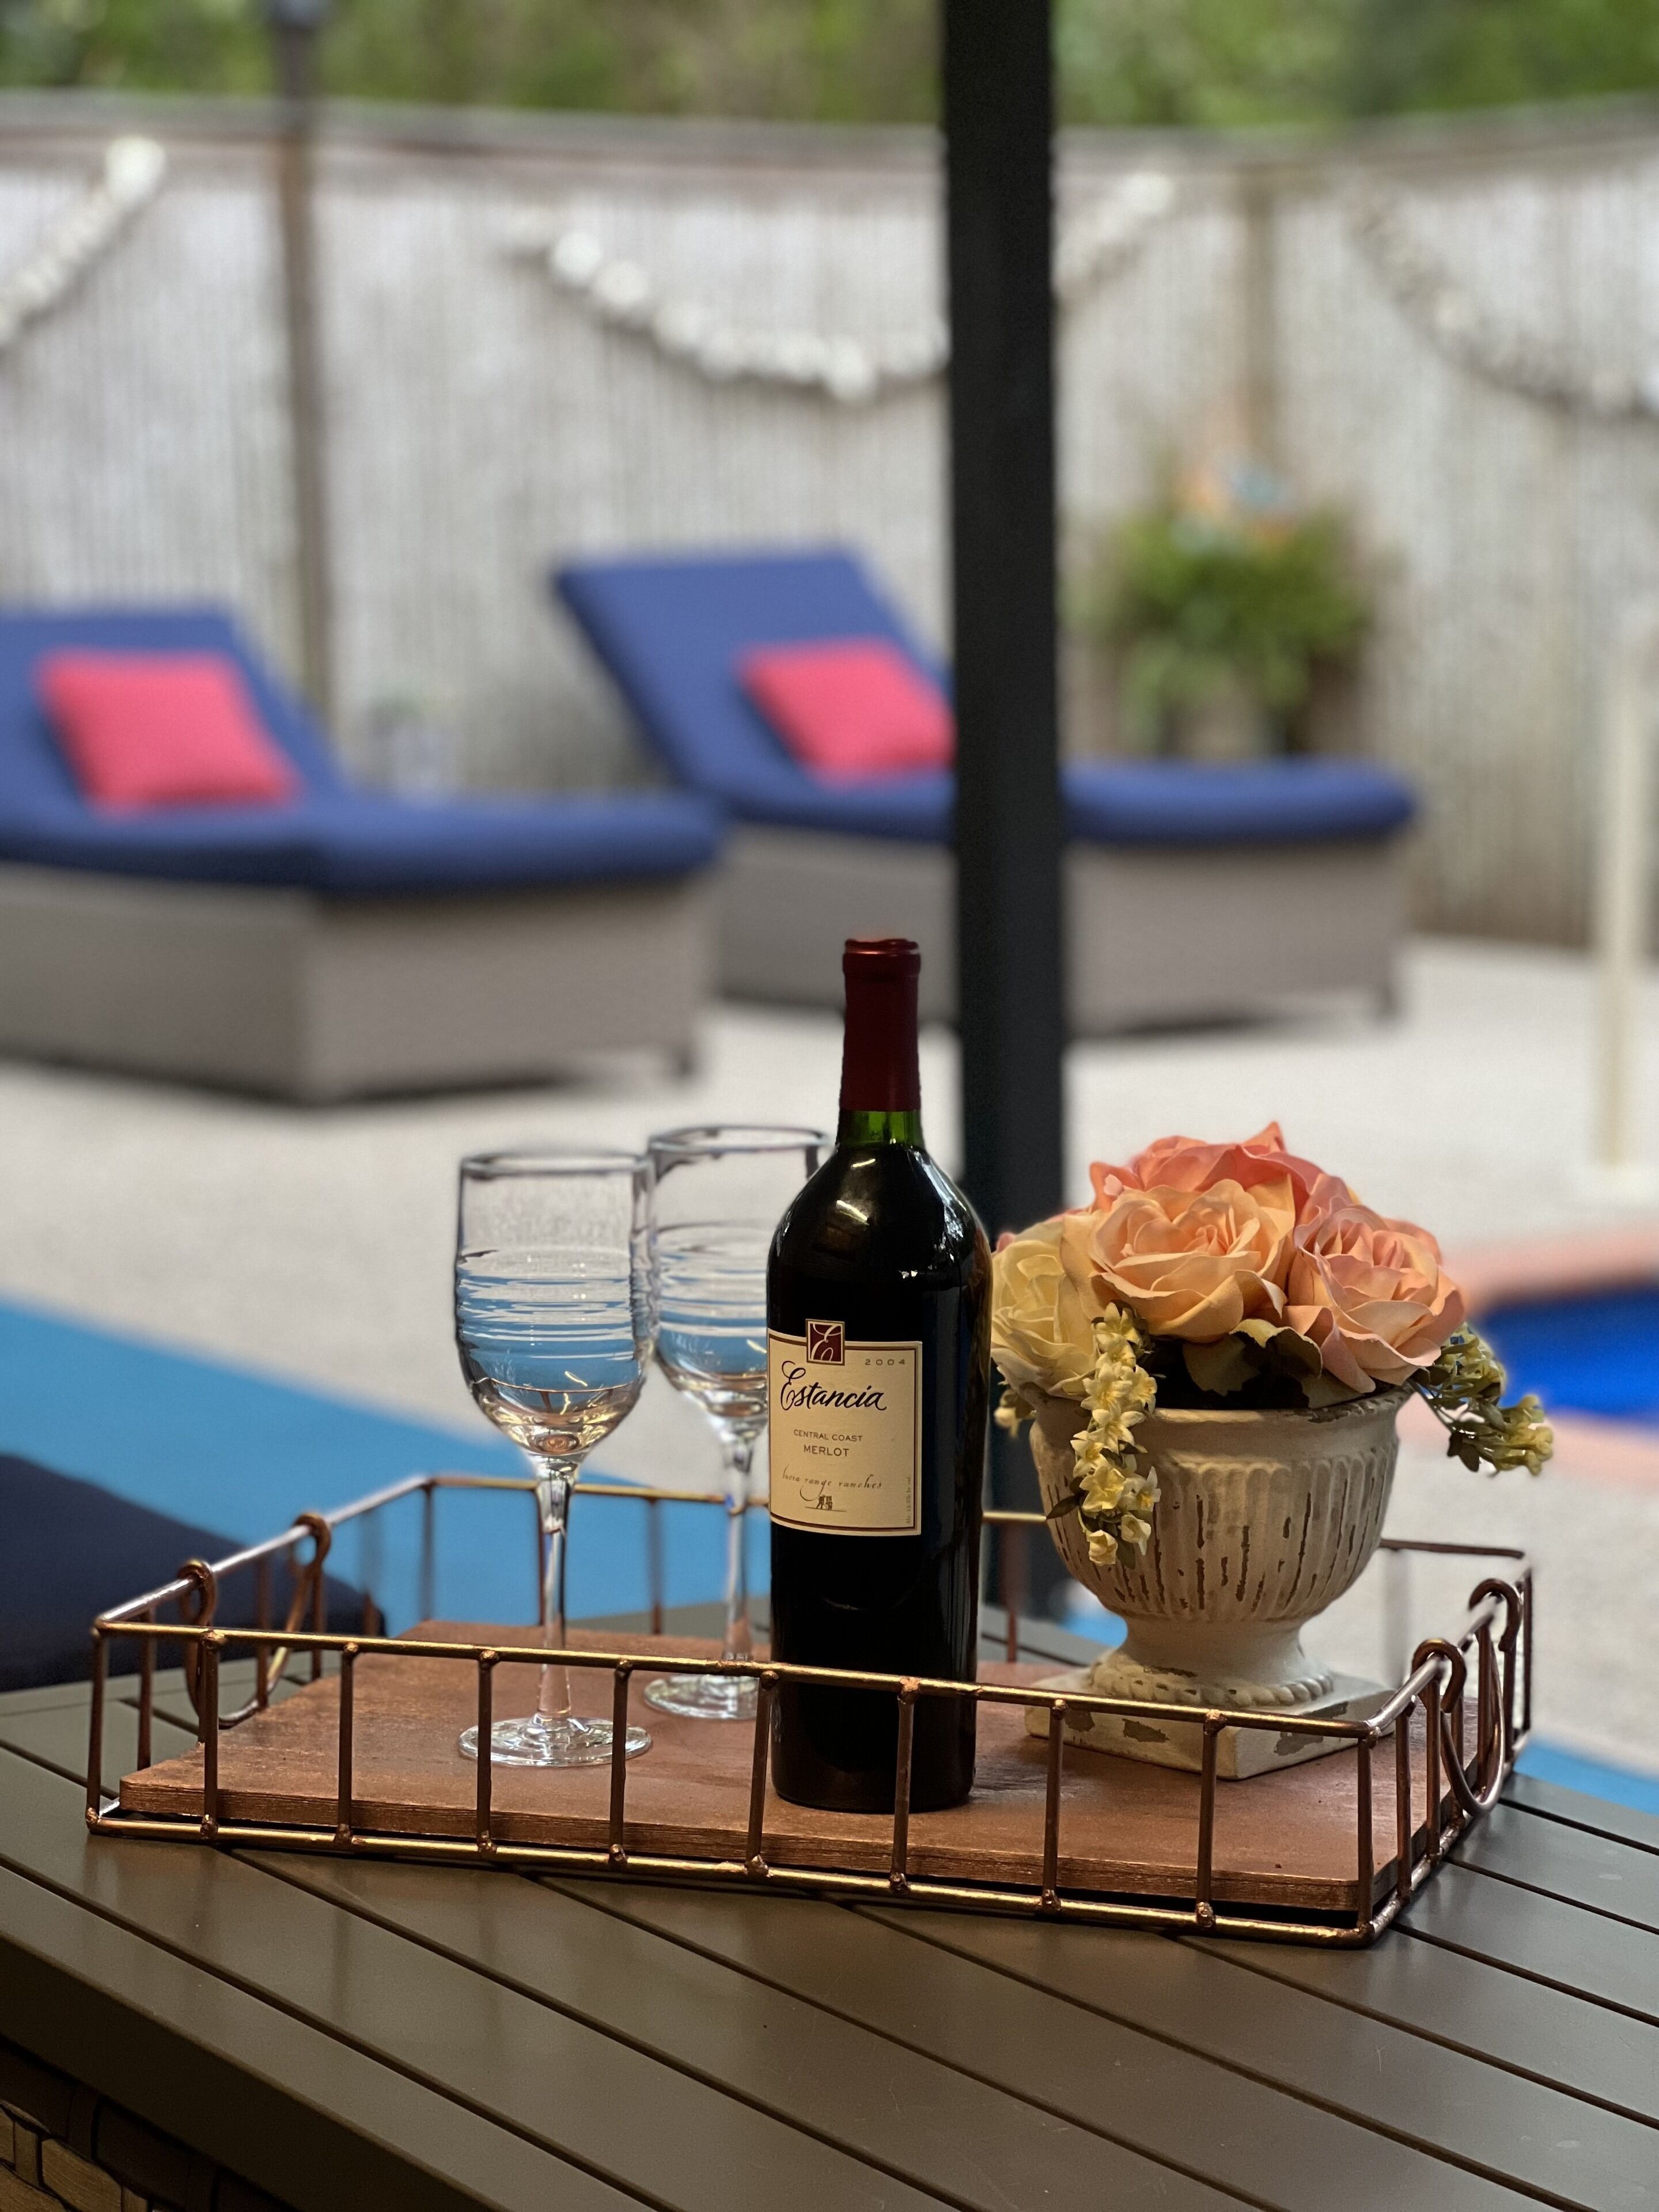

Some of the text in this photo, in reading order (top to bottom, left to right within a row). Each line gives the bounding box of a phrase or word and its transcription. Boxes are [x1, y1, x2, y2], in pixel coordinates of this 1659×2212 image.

[780, 1360, 887, 1411] Estancia
[793, 1429, 863, 1442] CENTRAL COAST
[803, 1444, 850, 1457] MERLOT
[804, 1478, 832, 1493] range
[838, 1474, 882, 1489] ranches
